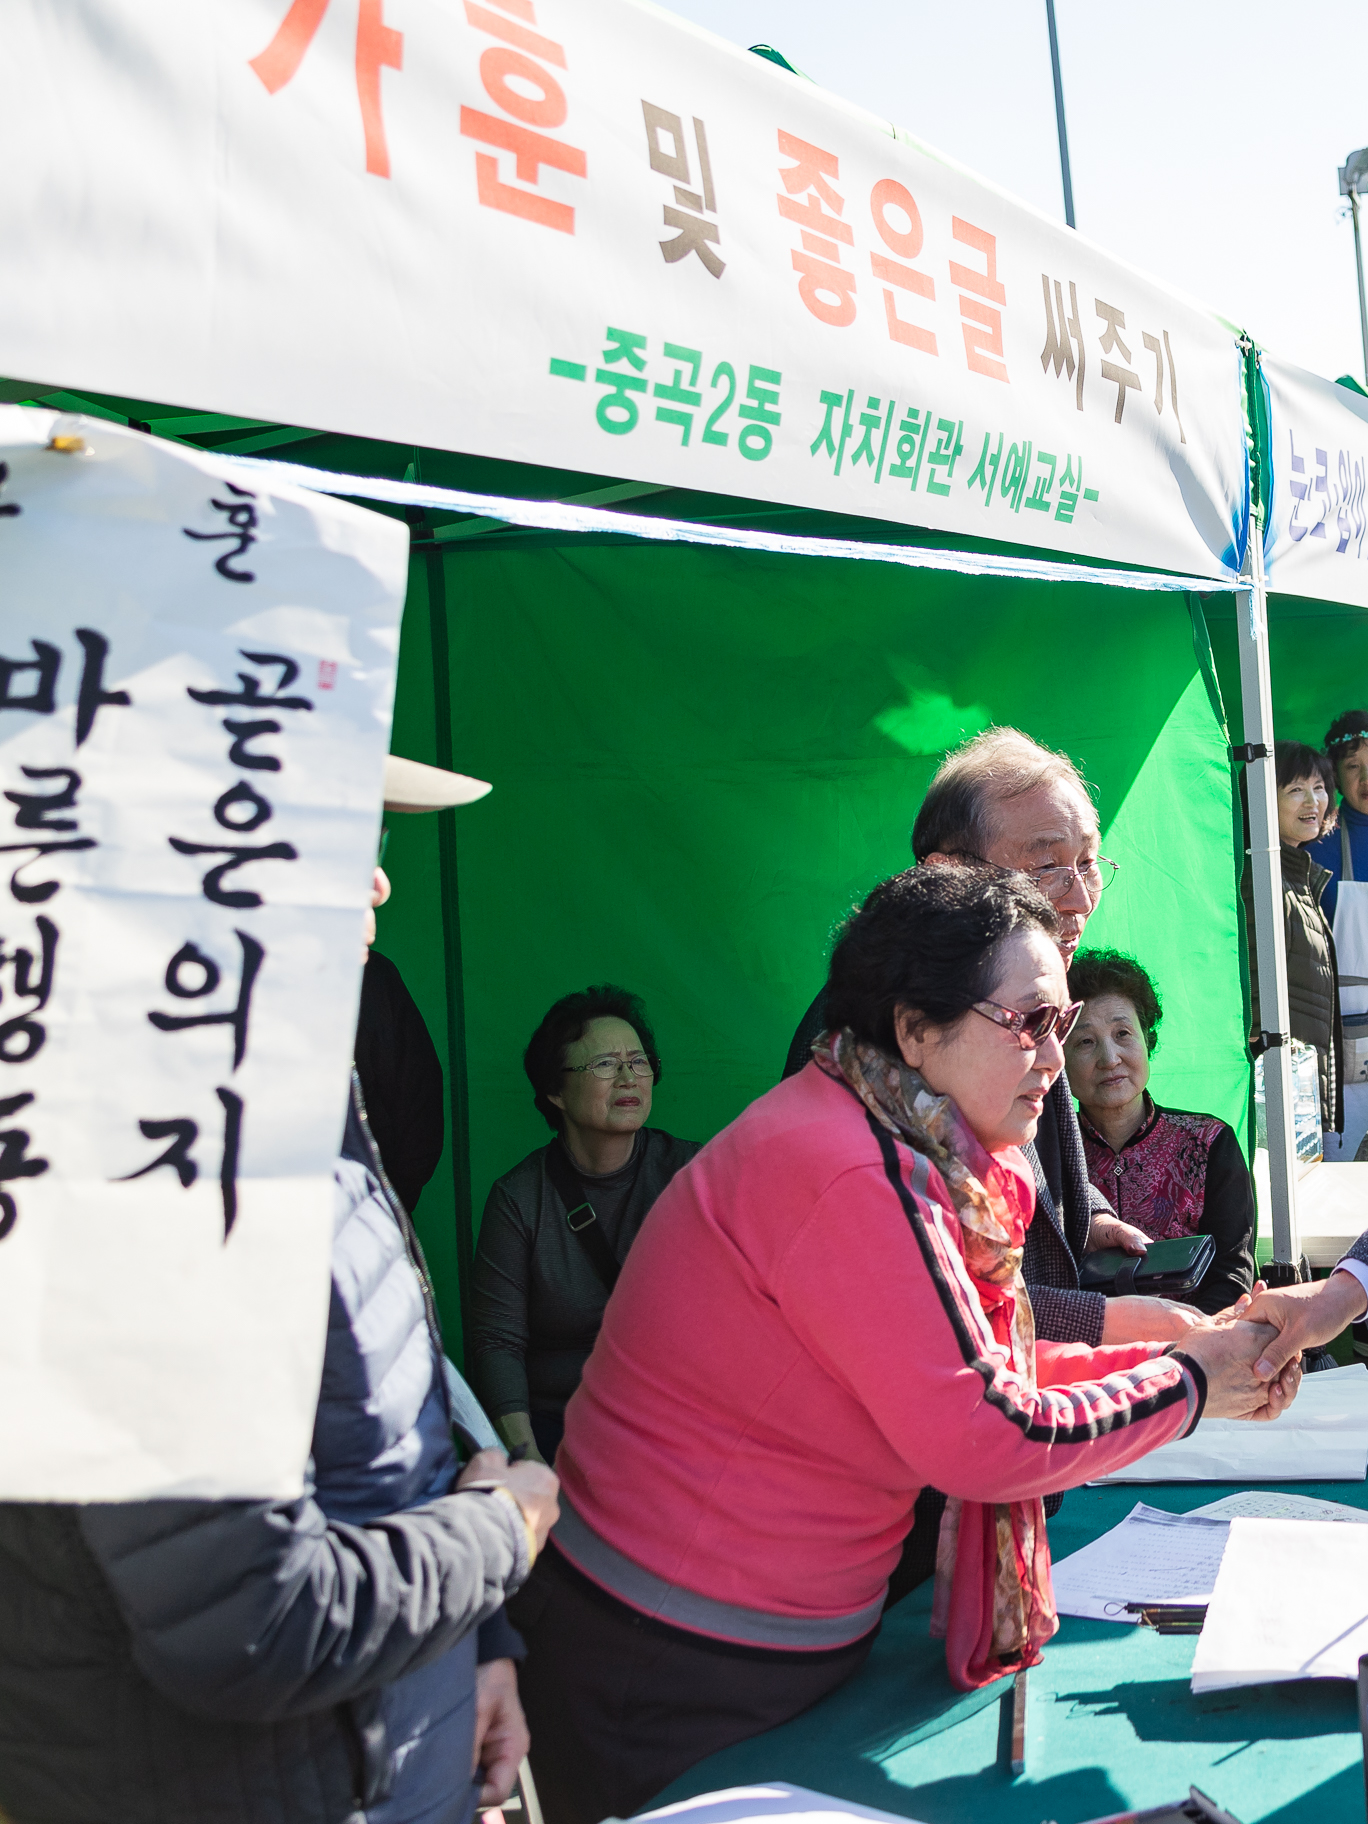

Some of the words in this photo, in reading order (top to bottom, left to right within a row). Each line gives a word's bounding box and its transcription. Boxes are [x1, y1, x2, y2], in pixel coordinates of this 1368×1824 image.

[640, 98, 727, 280] 및
[1040, 272, 1187, 444] 써주기
[548, 325, 783, 462] -중곡2동
[809, 387, 964, 498] 자치회관
[966, 431, 1101, 525] 서예교실-
